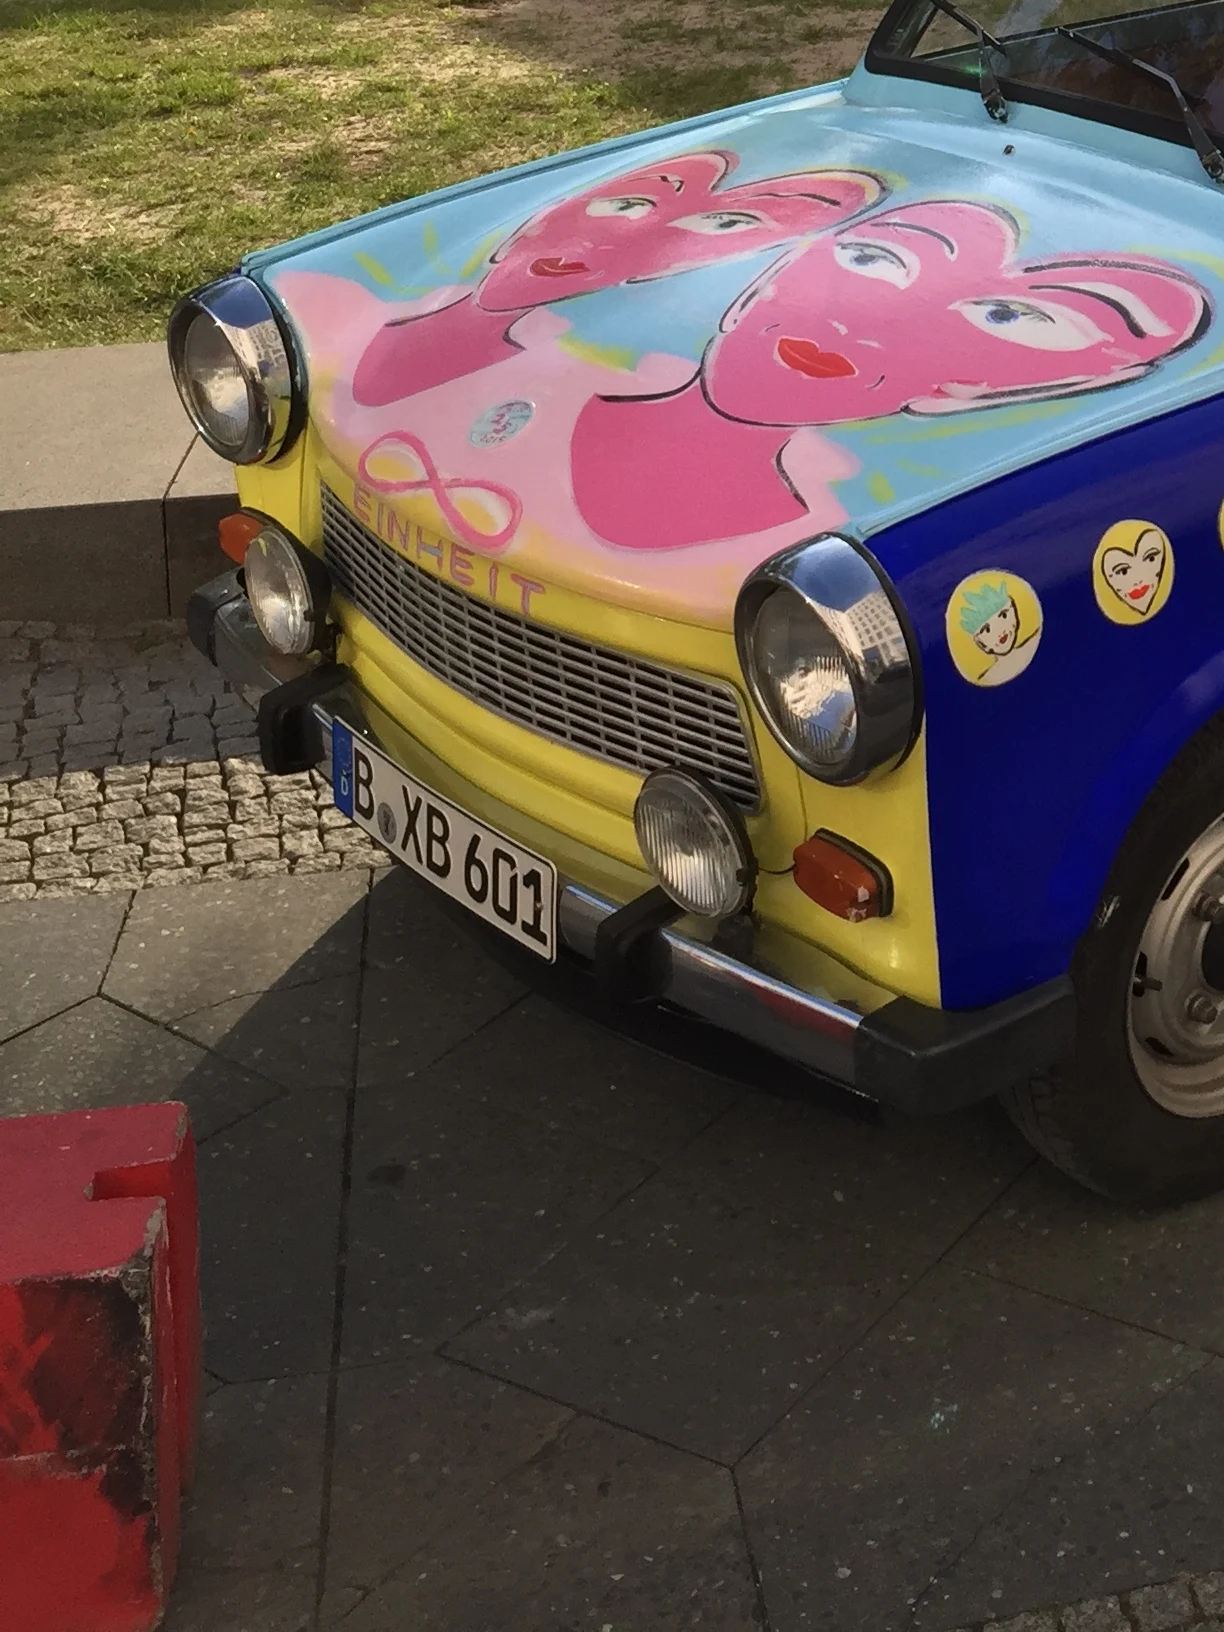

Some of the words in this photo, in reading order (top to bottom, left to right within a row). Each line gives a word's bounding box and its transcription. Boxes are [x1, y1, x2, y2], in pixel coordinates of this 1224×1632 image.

[354, 482, 546, 616] EINHEIT
[340, 776, 349, 796] D
[354, 747, 375, 821] B
[401, 784, 451, 879] XB
[464, 833, 548, 946] 601
